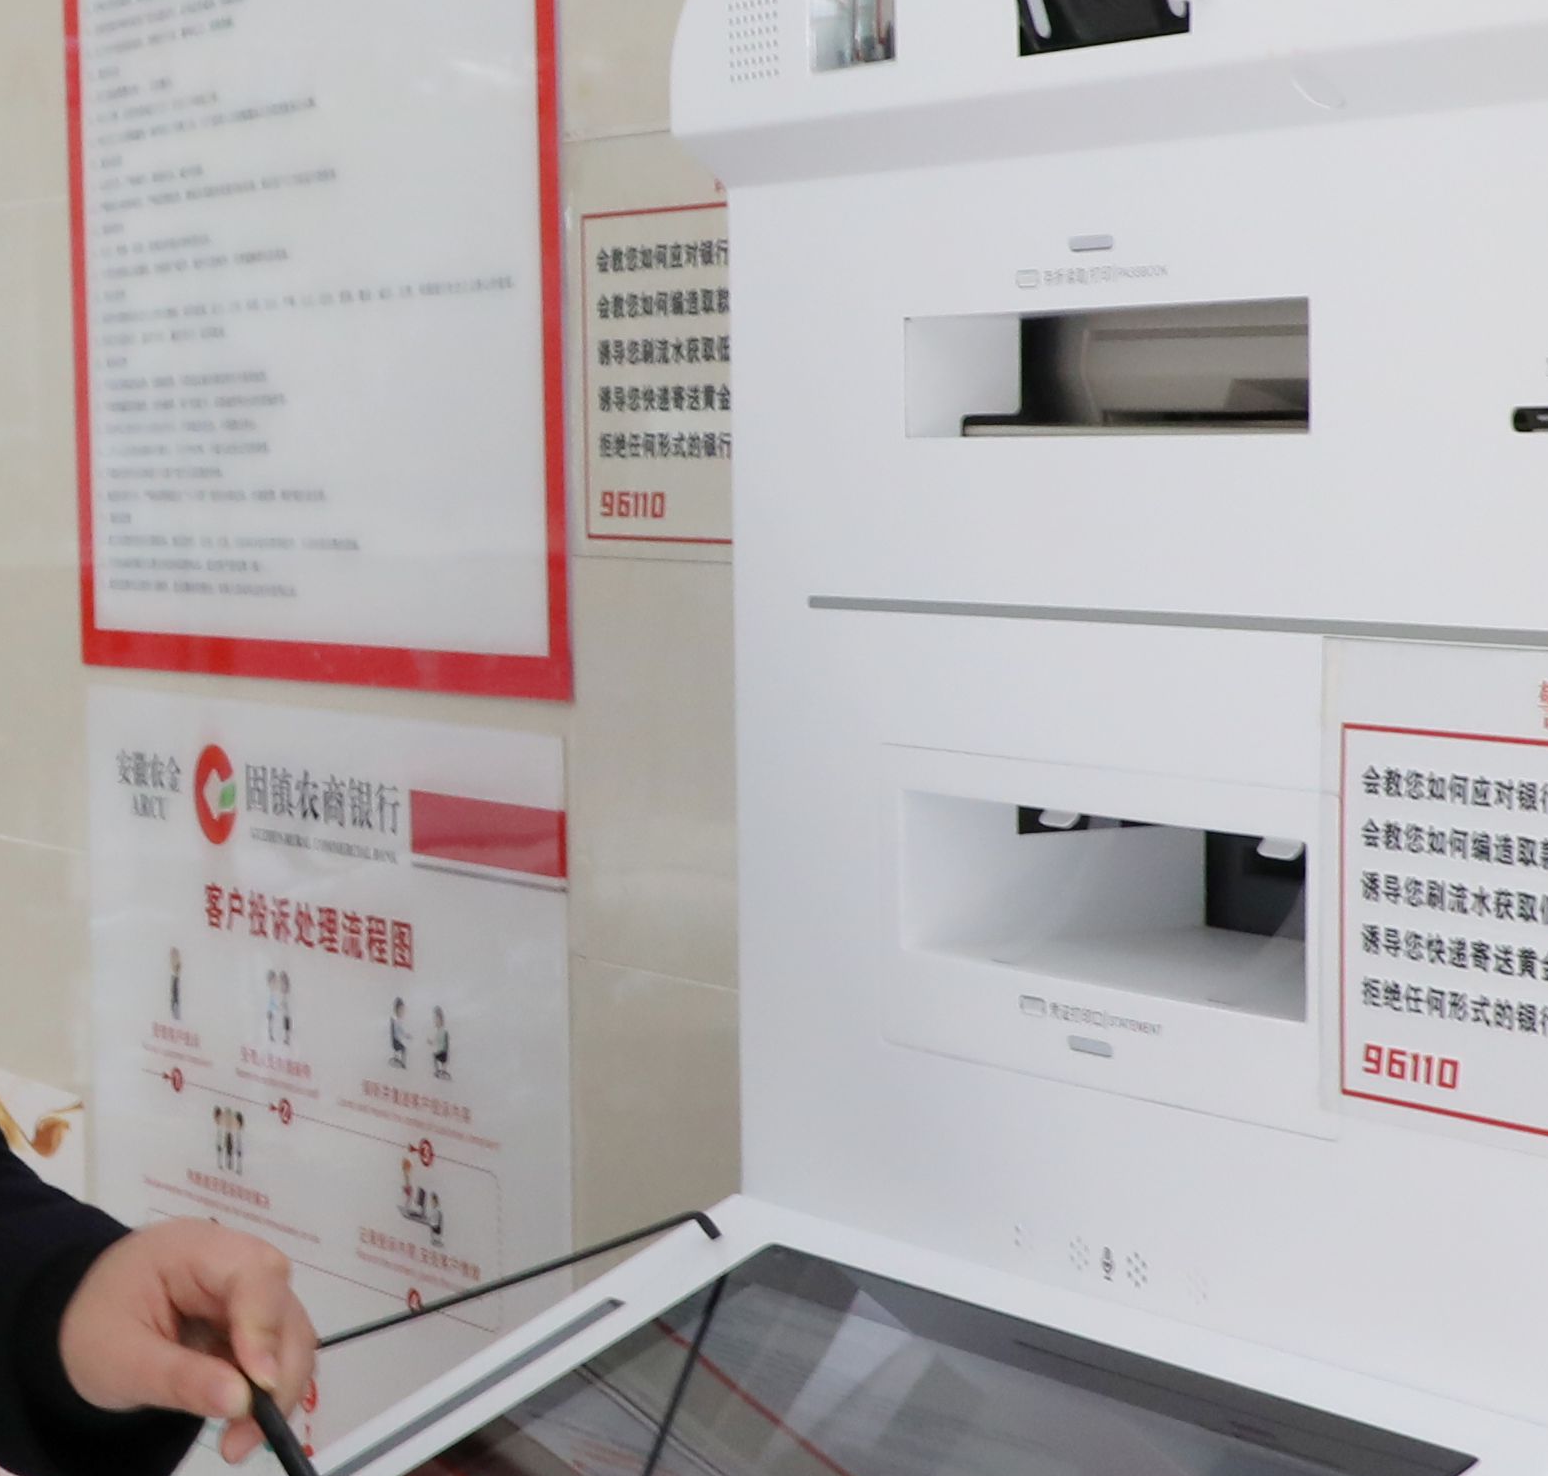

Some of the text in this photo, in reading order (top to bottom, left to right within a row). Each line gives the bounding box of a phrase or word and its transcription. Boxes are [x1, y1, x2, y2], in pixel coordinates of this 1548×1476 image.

[600, 490, 667, 520] 96110
[244, 762, 400, 836] 固镇农商银行
[205, 882, 413, 972] 客户投诉处理流程图
[1362, 1042, 1460, 1091] 96110
